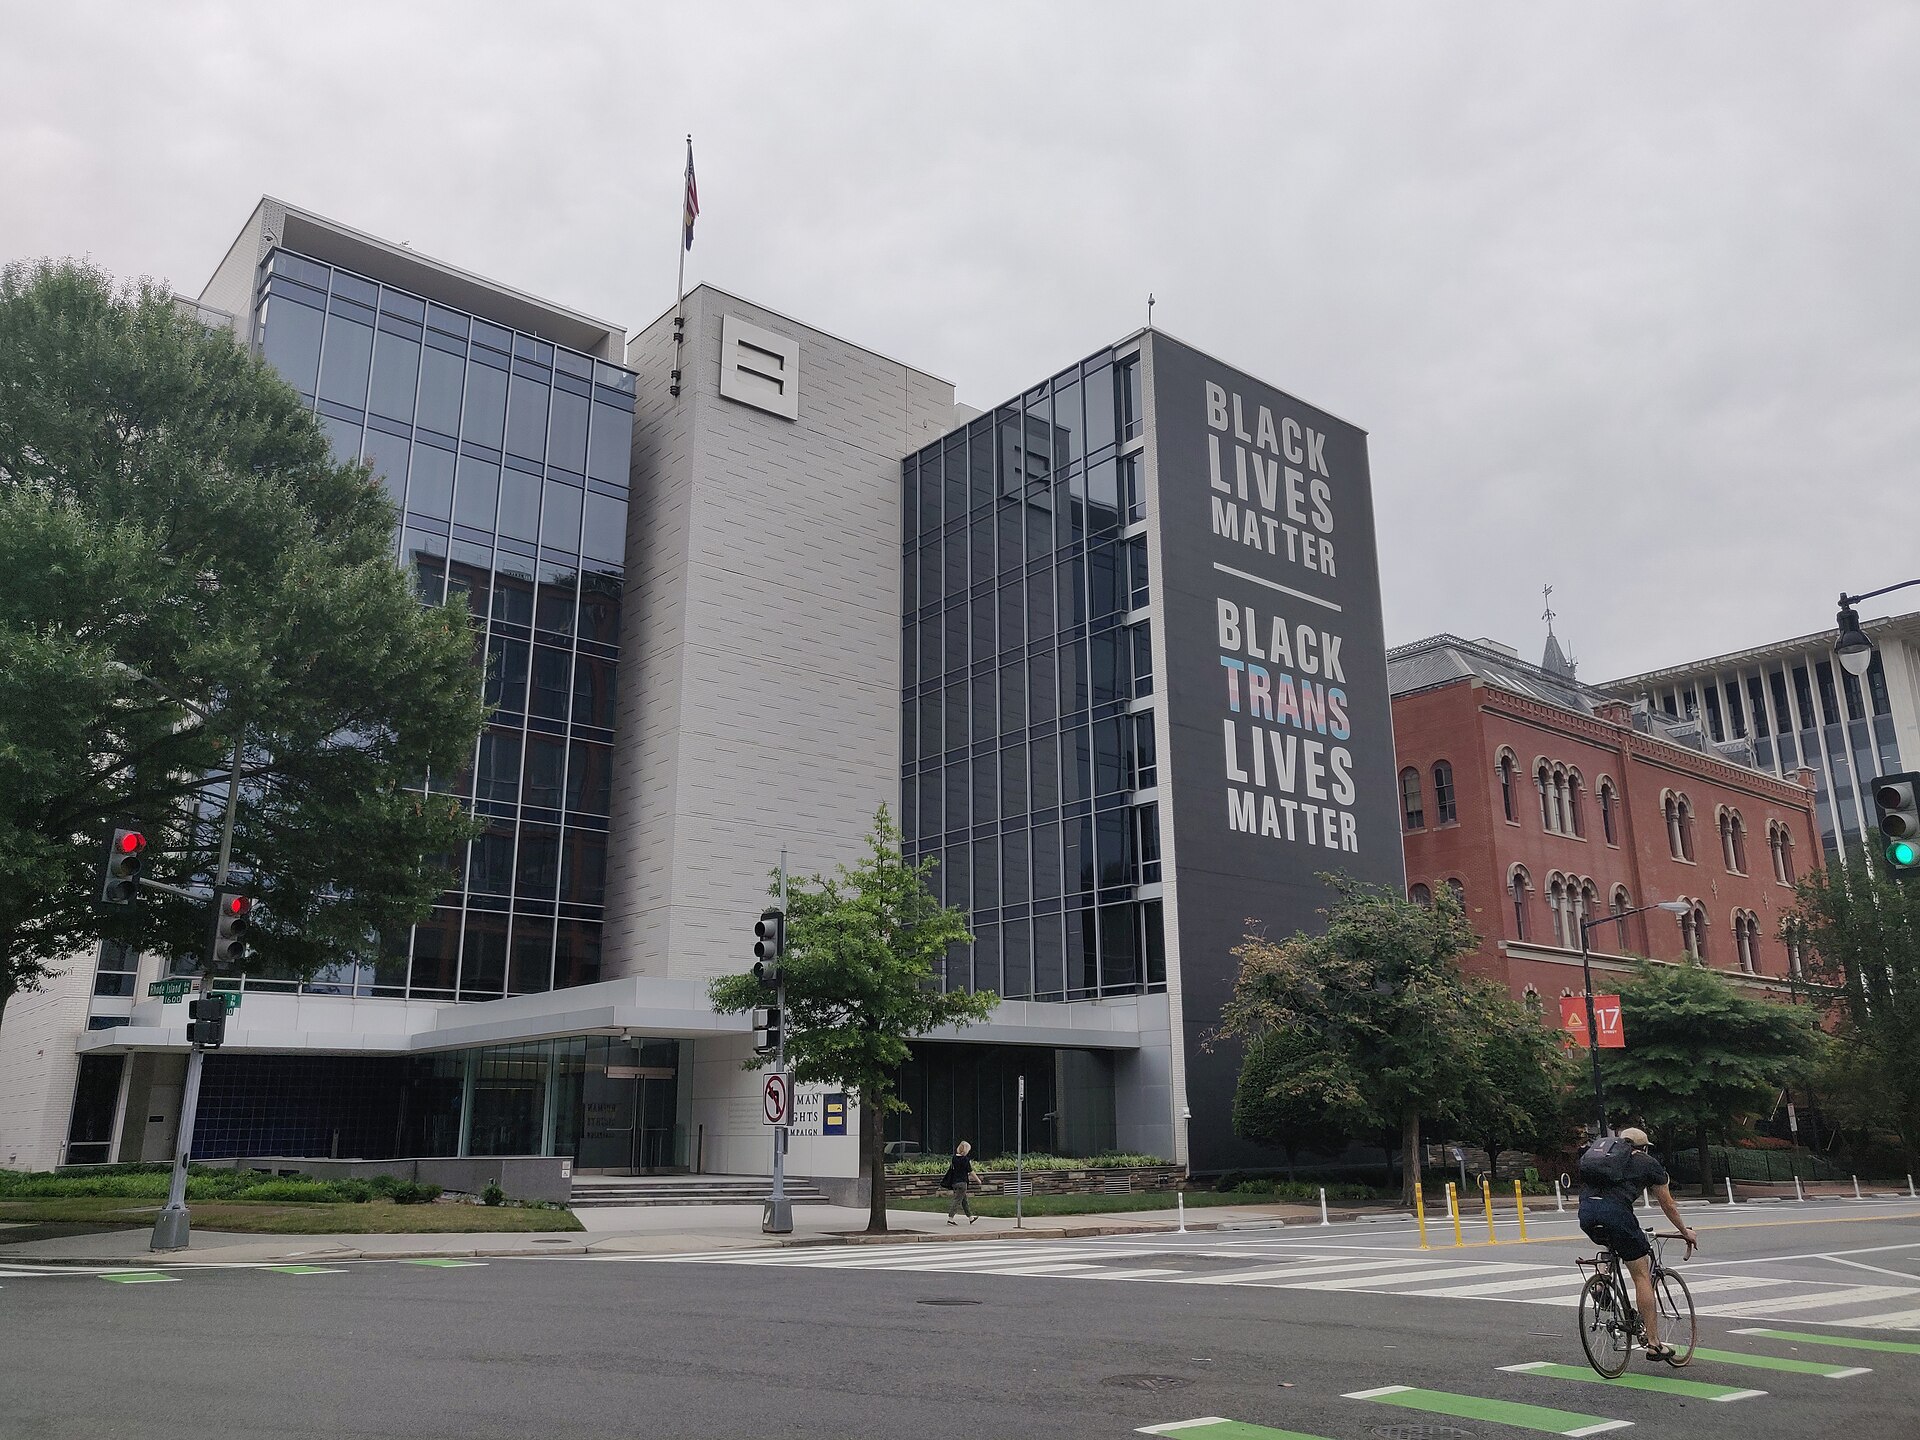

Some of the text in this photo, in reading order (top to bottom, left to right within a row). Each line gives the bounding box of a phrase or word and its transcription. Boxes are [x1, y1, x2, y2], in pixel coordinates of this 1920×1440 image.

[1205, 380, 1330, 478] BLACK
[1208, 433, 1334, 534] LIVES
[1211, 495, 1337, 578] MATTER
[1217, 597, 1346, 684] BLACK
[1220, 655, 1351, 741] TRANS
[1223, 718, 1356, 806] LIVES
[1227, 787, 1359, 854] MATTER
[150, 982, 182, 995] Rhode Island
[164, 995, 182, 1004] 1600
[1597, 1008, 1620, 1030] 17
[795, 1095, 819, 1105] MAN
